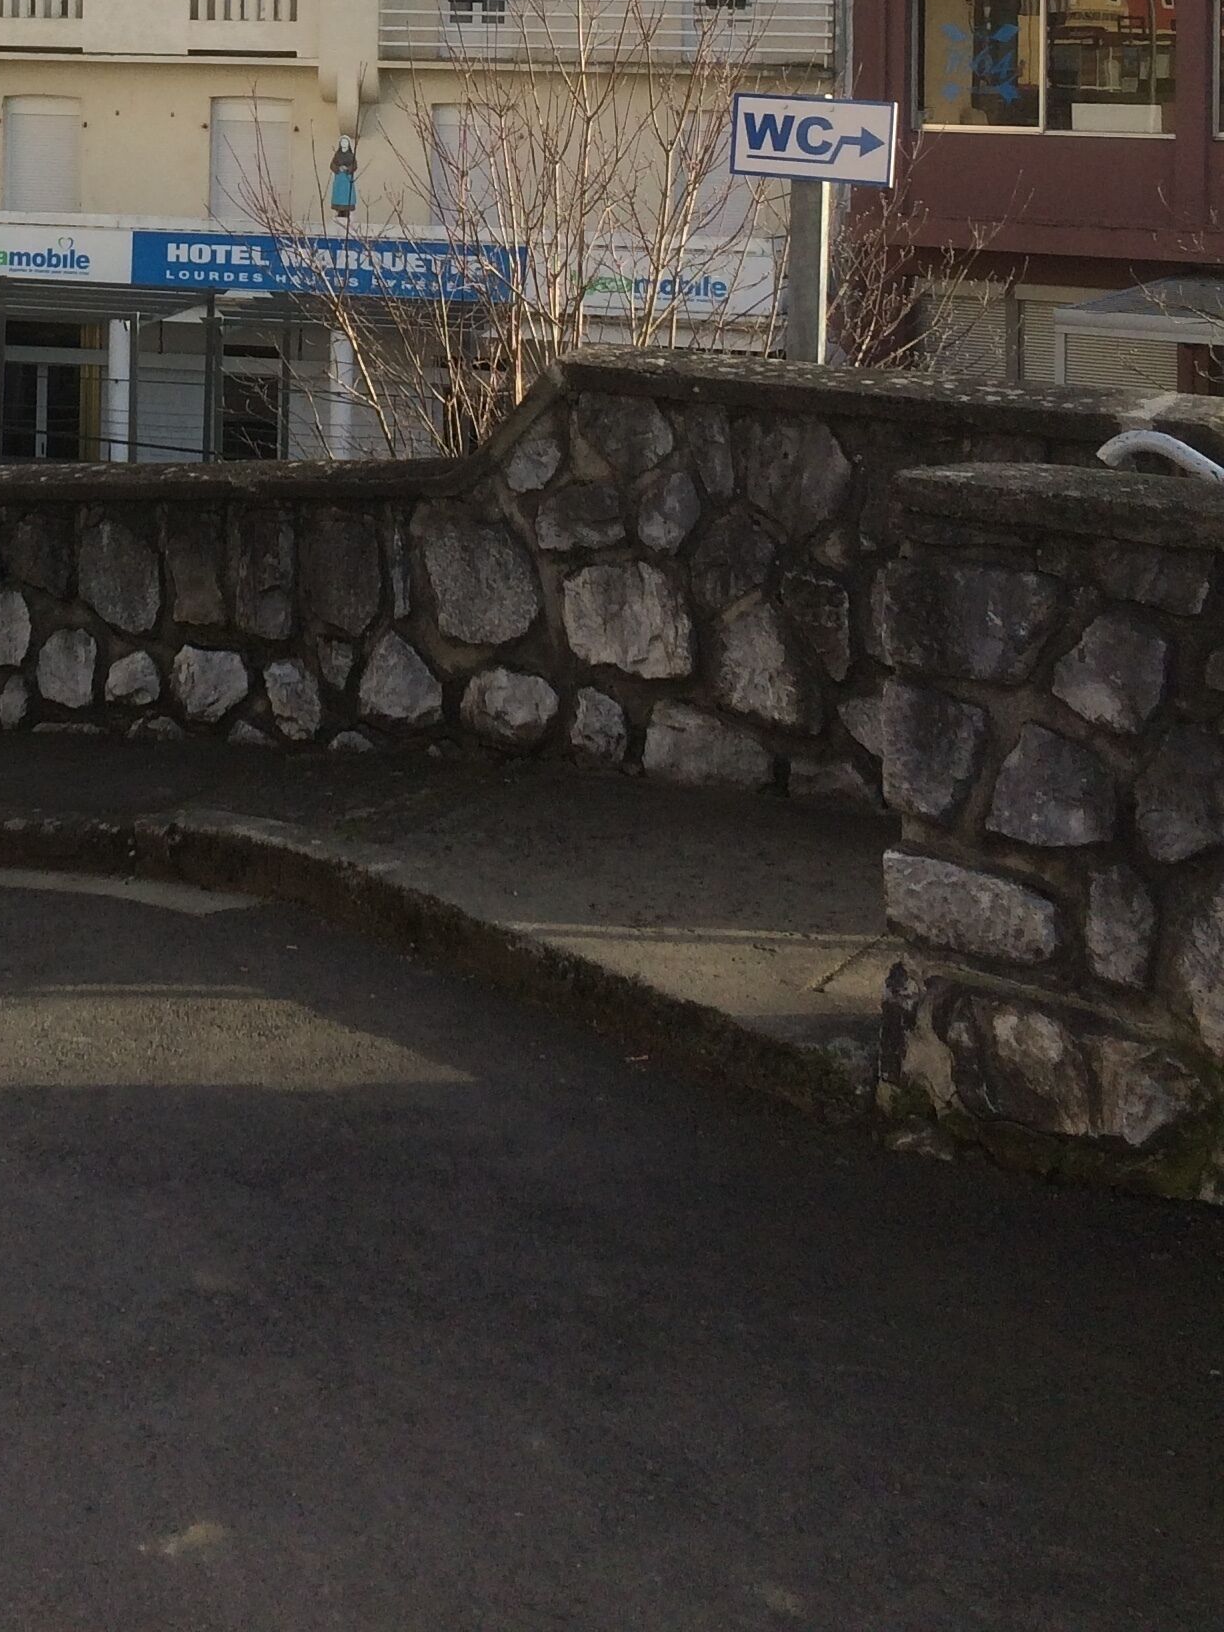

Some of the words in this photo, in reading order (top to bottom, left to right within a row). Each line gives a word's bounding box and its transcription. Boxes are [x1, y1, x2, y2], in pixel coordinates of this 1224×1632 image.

[743, 112, 834, 156] WC
[167, 242, 270, 266] HOTEL
[166, 269, 264, 283] LOURDES
[275, 273, 360, 287] HAUES
